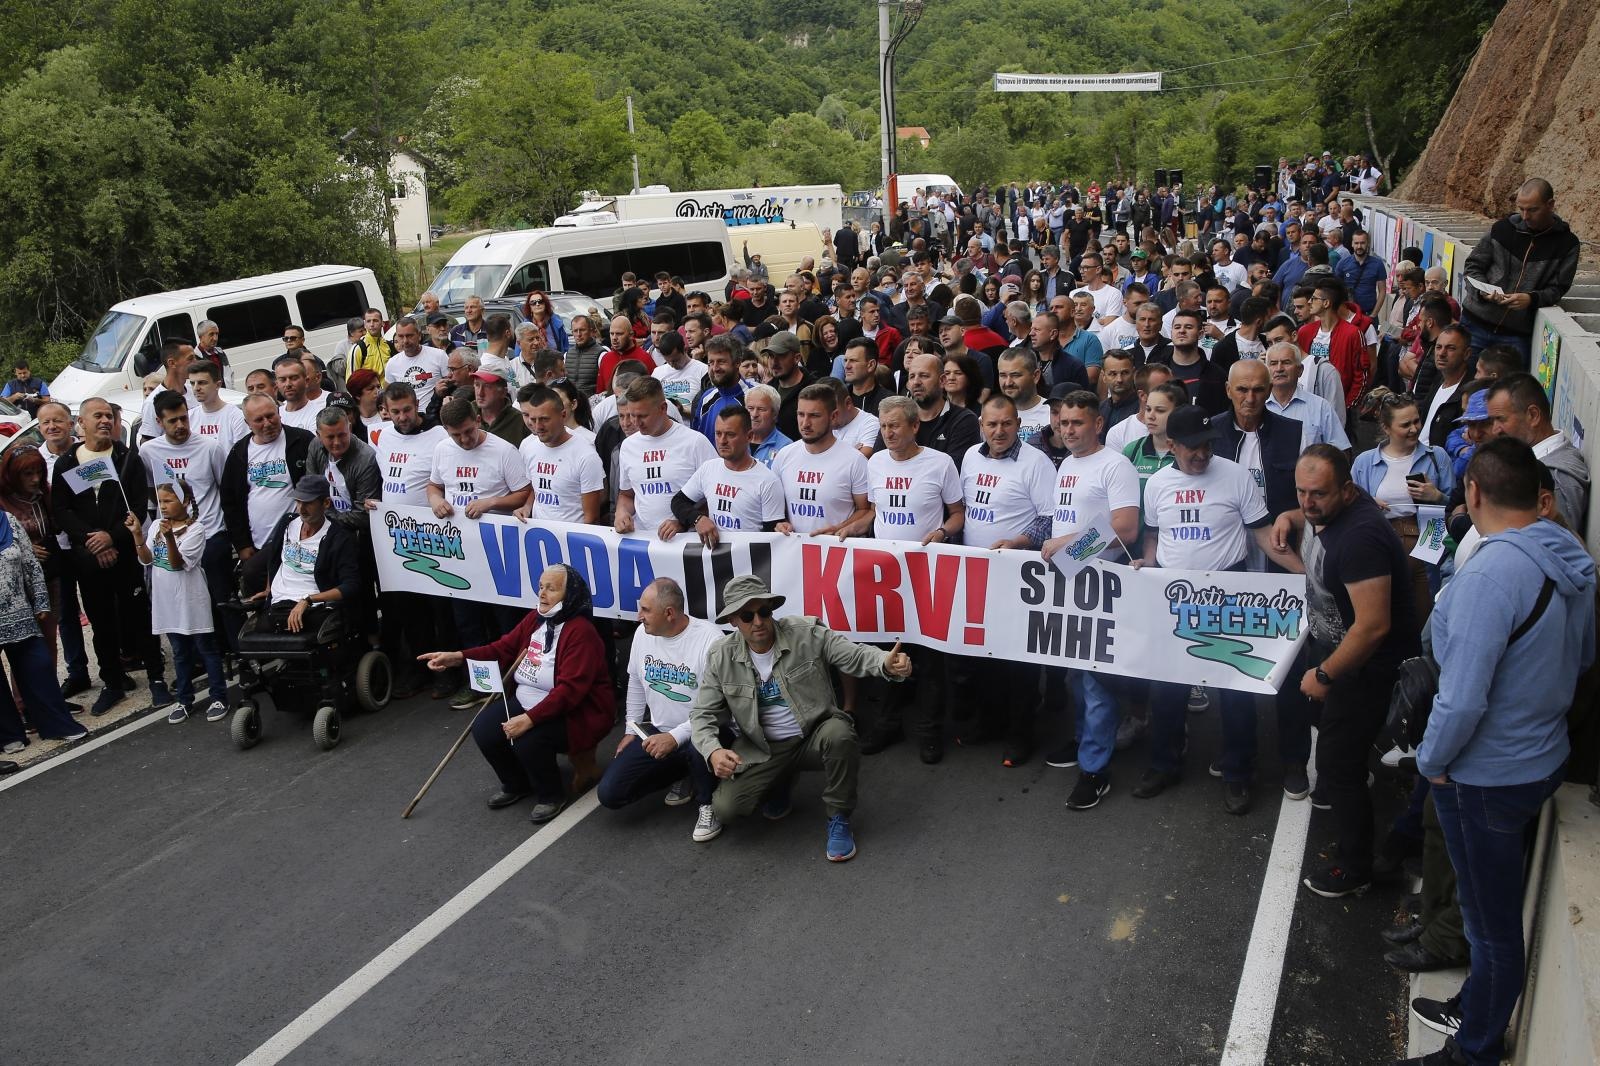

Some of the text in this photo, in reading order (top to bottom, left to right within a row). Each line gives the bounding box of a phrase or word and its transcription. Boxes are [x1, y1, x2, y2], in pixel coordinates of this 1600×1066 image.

[732, 204, 757, 219] me
[758, 198, 784, 219] da
[200, 424, 220, 435] KRV
[389, 452, 409, 463] KRV
[643, 450, 666, 462] KRV
[389, 467, 402, 477] ILI
[456, 467, 479, 478] KRV
[537, 462, 557, 475] KRV
[646, 467, 661, 479] ILI
[797, 471, 824, 484] KRV
[886, 477, 912, 490] KRV
[976, 473, 1001, 488] KRV
[1060, 475, 1079, 488] KRV
[640, 482, 672, 495] VODA
[715, 483, 740, 498] KRV
[799, 488, 816, 500] ILI
[889, 495, 906, 507] ILI
[975, 490, 991, 504] ILI
[1059, 493, 1072, 505] ILI
[1175, 490, 1205, 503] KRV
[717, 499, 732, 512] ILI
[791, 503, 825, 518] VODA
[882, 511, 915, 525] VODA
[1180, 509, 1200, 523] ILI
[385, 510, 461, 538] Pusti me da
[1171, 526, 1211, 540] VODA
[479, 522, 657, 613] VODA
[802, 543, 989, 646] KRV!
[1020, 560, 1122, 614] STOP
[1165, 578, 1304, 611] Pusti me da
[1170, 595, 1303, 641] TEČEM
[1026, 610, 1116, 664] MHE
